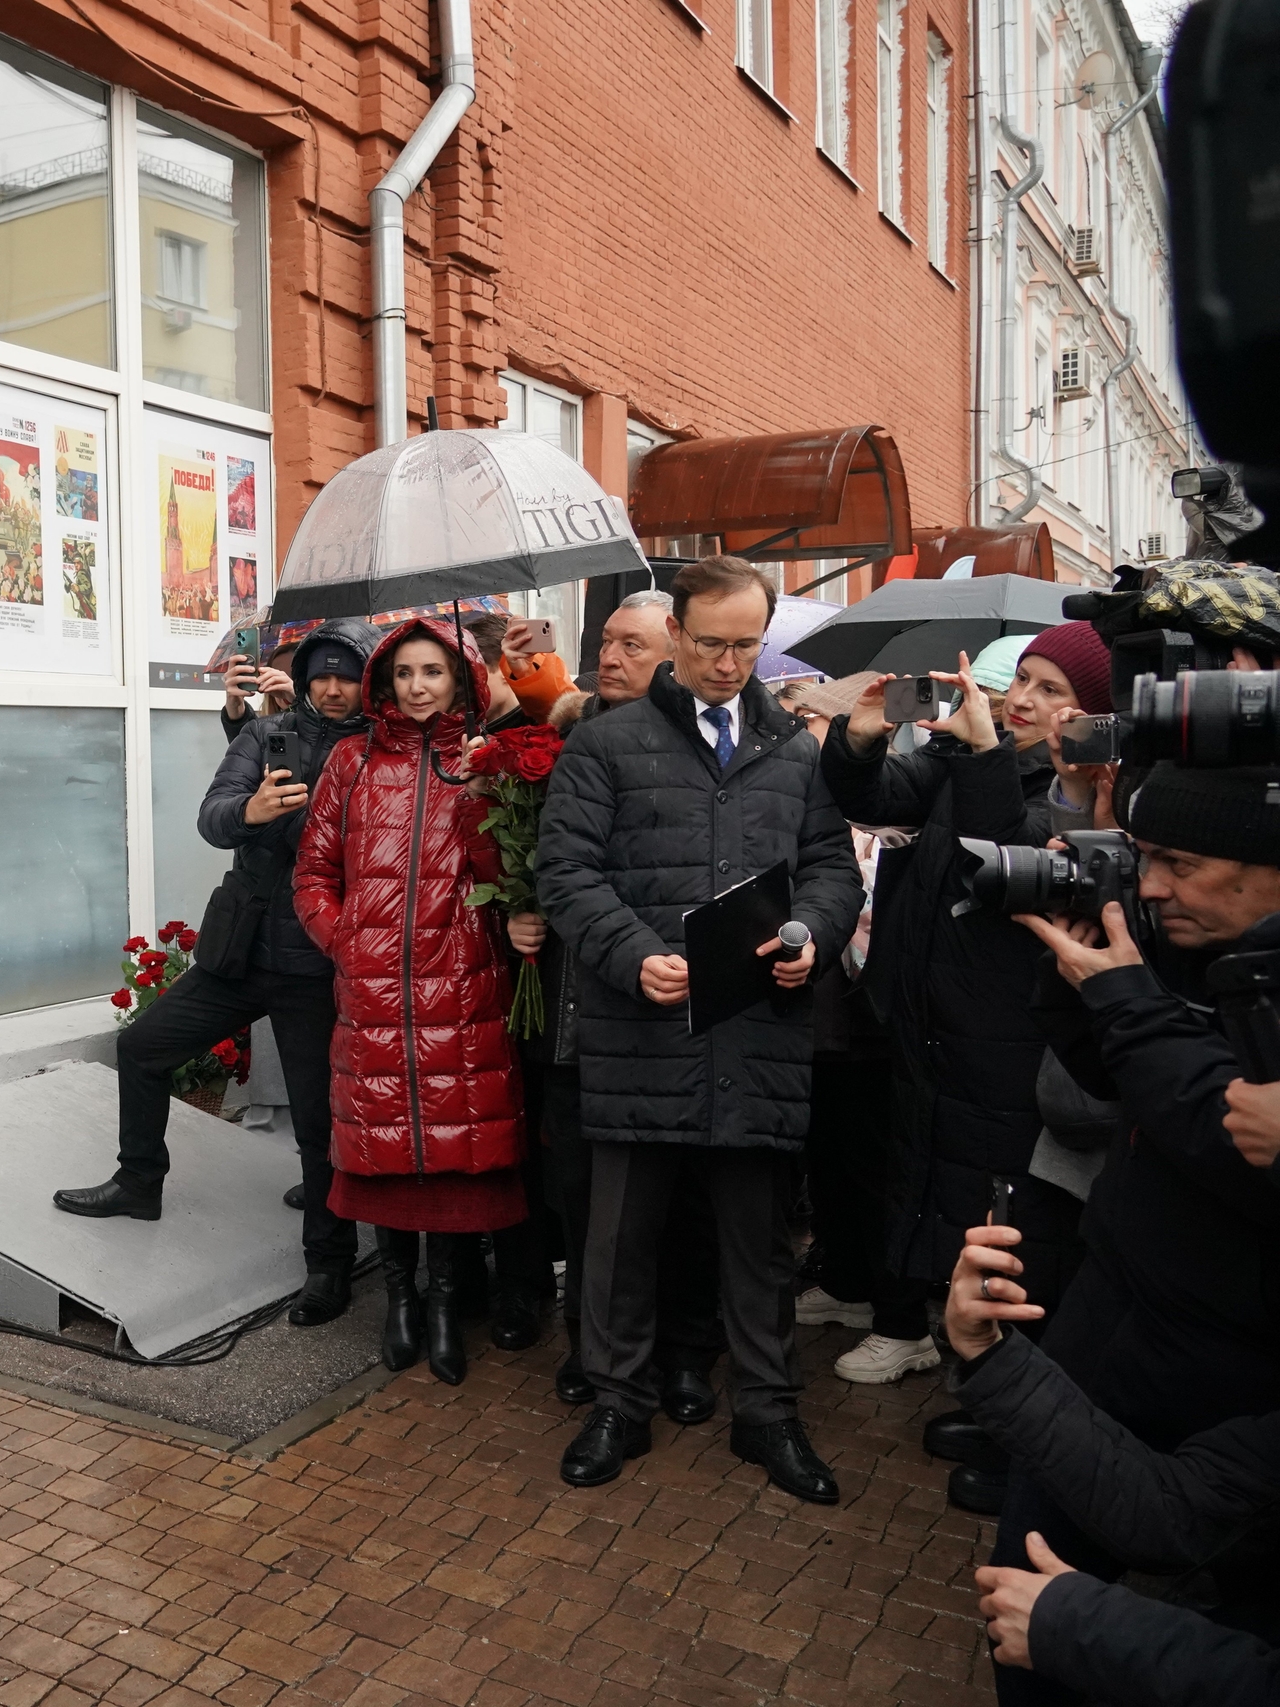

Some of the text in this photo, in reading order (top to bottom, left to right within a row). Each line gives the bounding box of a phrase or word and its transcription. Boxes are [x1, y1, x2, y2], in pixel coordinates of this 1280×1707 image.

[5, 428, 18, 439] ВОИНУ
[20, 432, 36, 443] СЛАВА!
[206, 451, 215, 462] 1246
[174, 468, 215, 492] ПОБЕДА!
[552, 488, 575, 515] by
